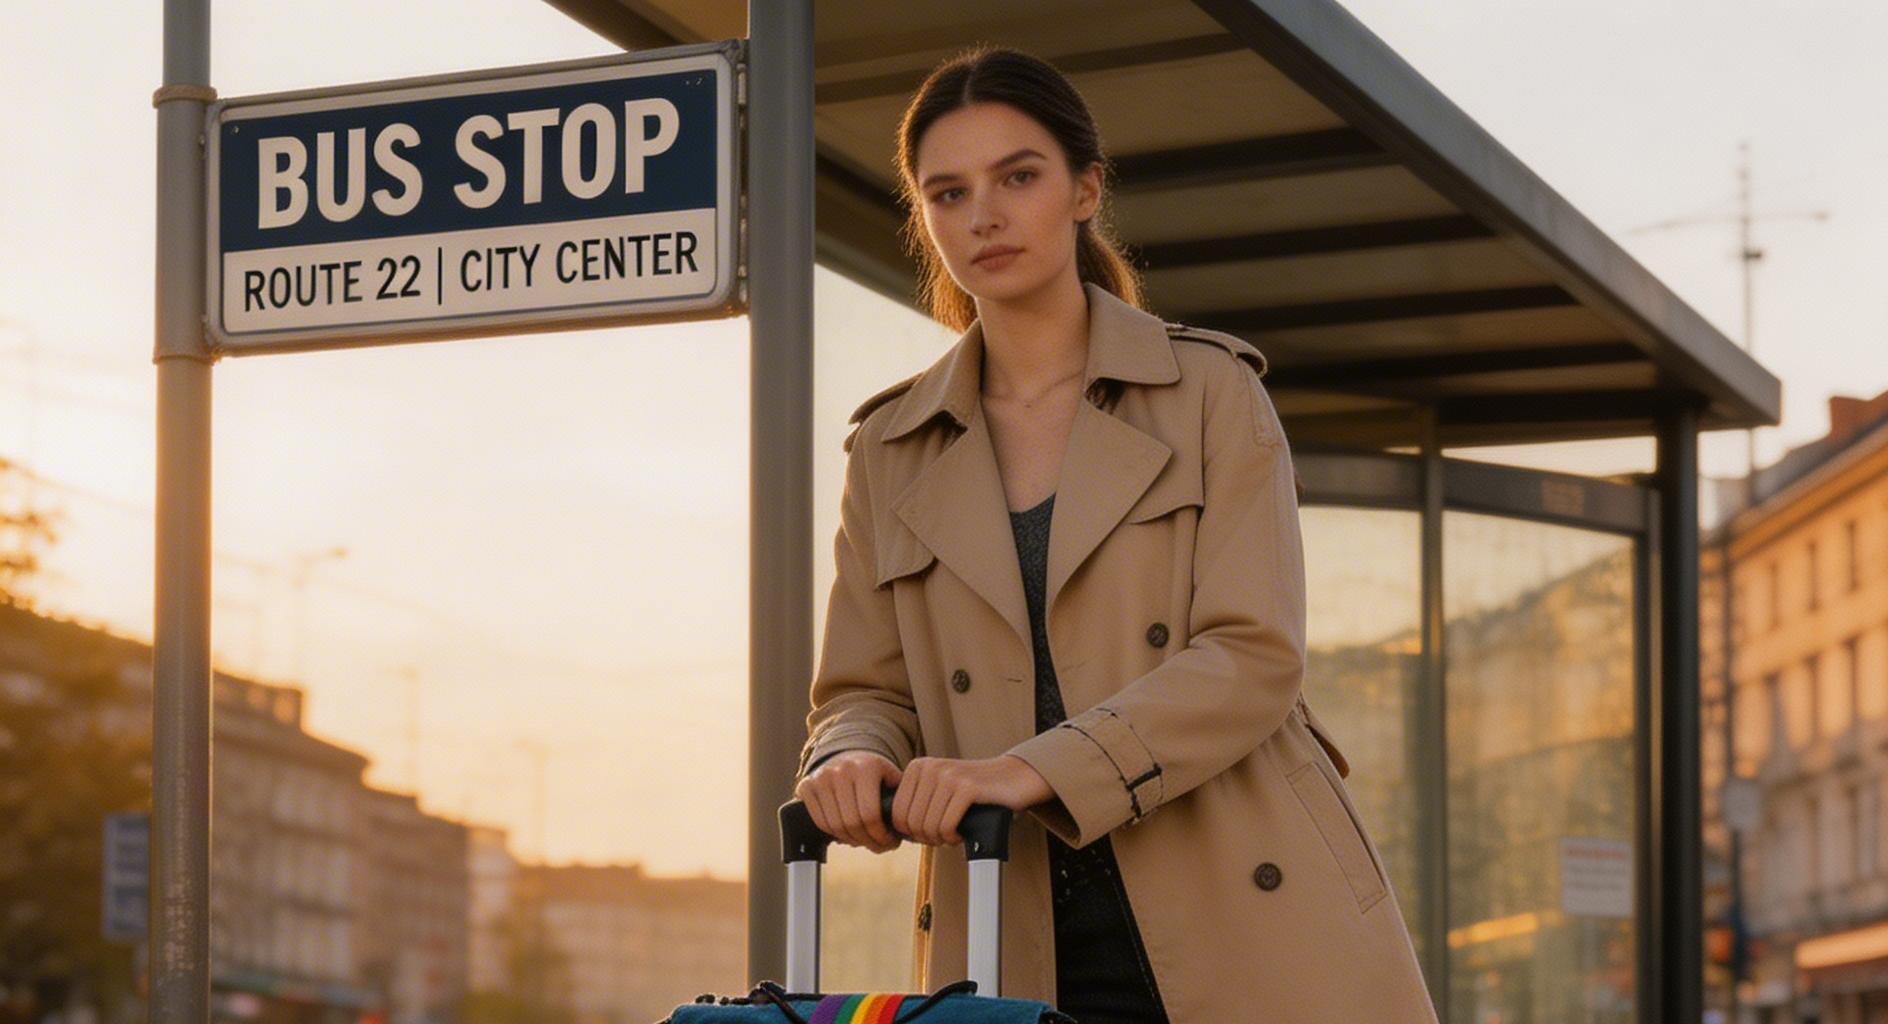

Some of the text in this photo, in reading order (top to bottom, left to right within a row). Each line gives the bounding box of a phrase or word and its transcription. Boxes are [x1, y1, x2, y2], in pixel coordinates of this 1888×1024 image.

[258, 98, 680, 230] BUS STOP
[244, 261, 363, 312] ROUTE
[375, 255, 421, 301] 22
[460, 244, 541, 293] CITY
[556, 231, 698, 284] CENTER
